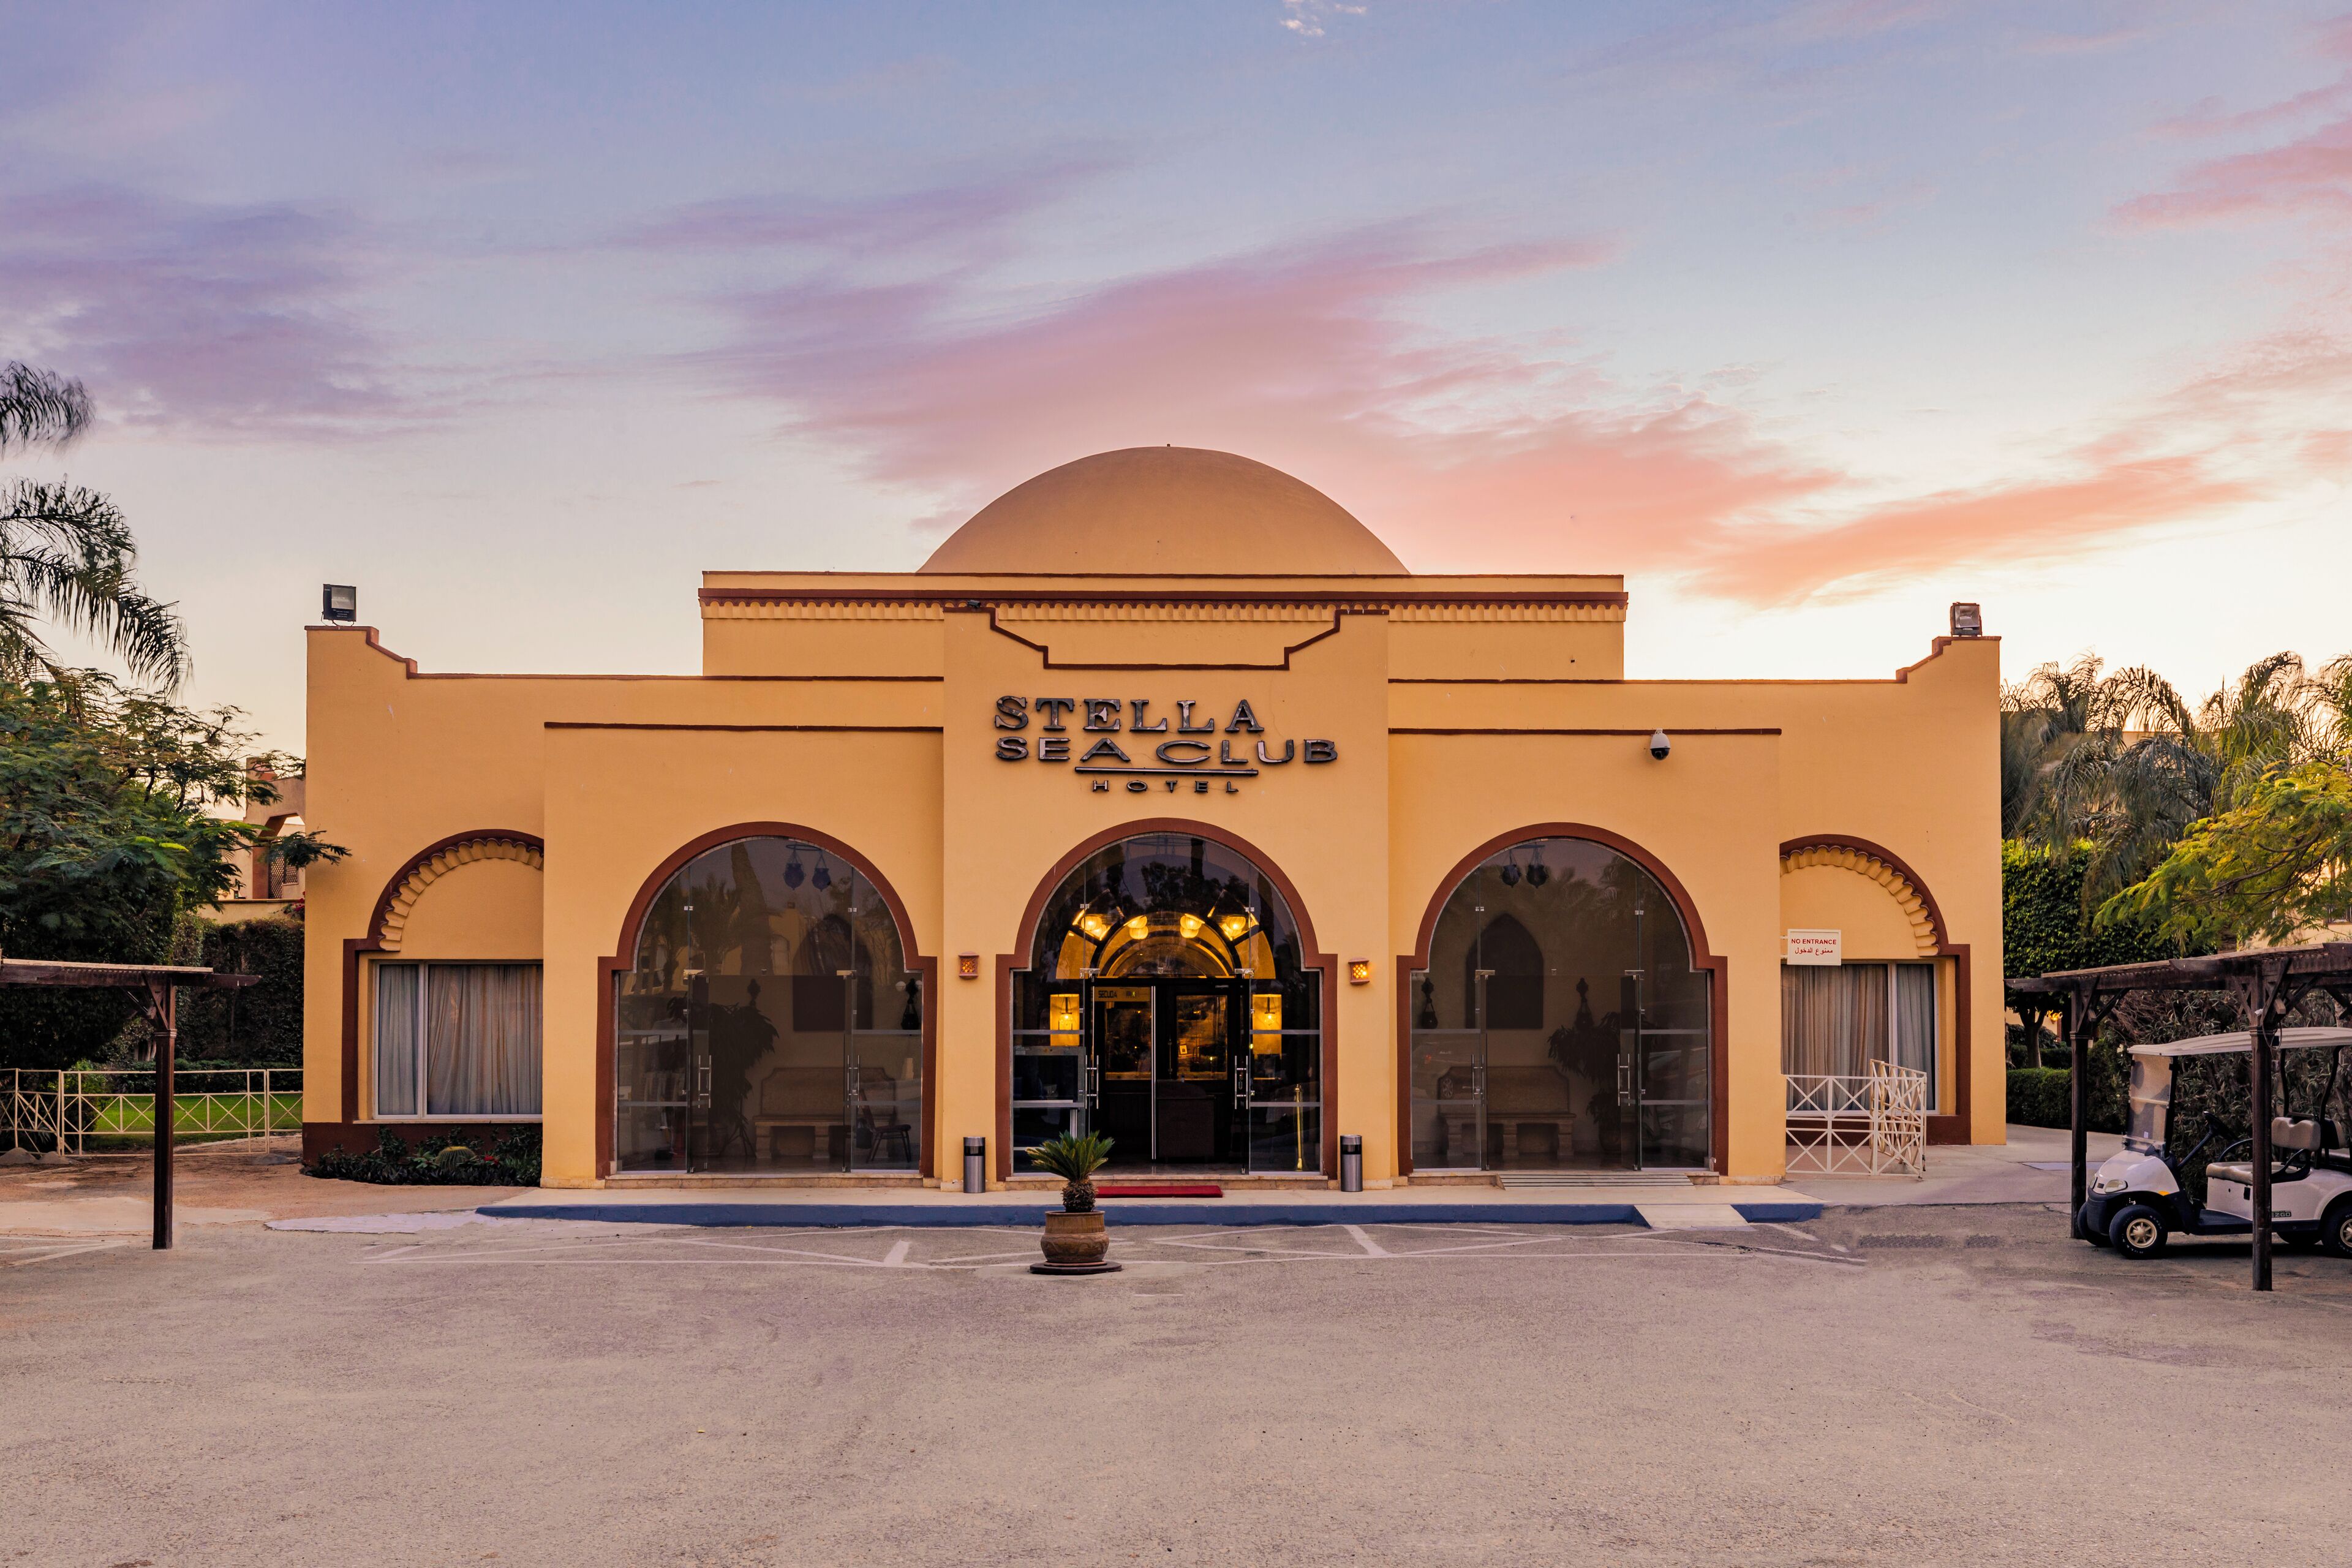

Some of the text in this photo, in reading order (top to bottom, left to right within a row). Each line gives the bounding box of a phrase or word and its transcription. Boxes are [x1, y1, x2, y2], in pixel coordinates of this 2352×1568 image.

[994, 695, 1265, 733] STELLA
[995, 737, 1338, 763] SEA CLUB
[1092, 780, 1239, 793] HOTEL
